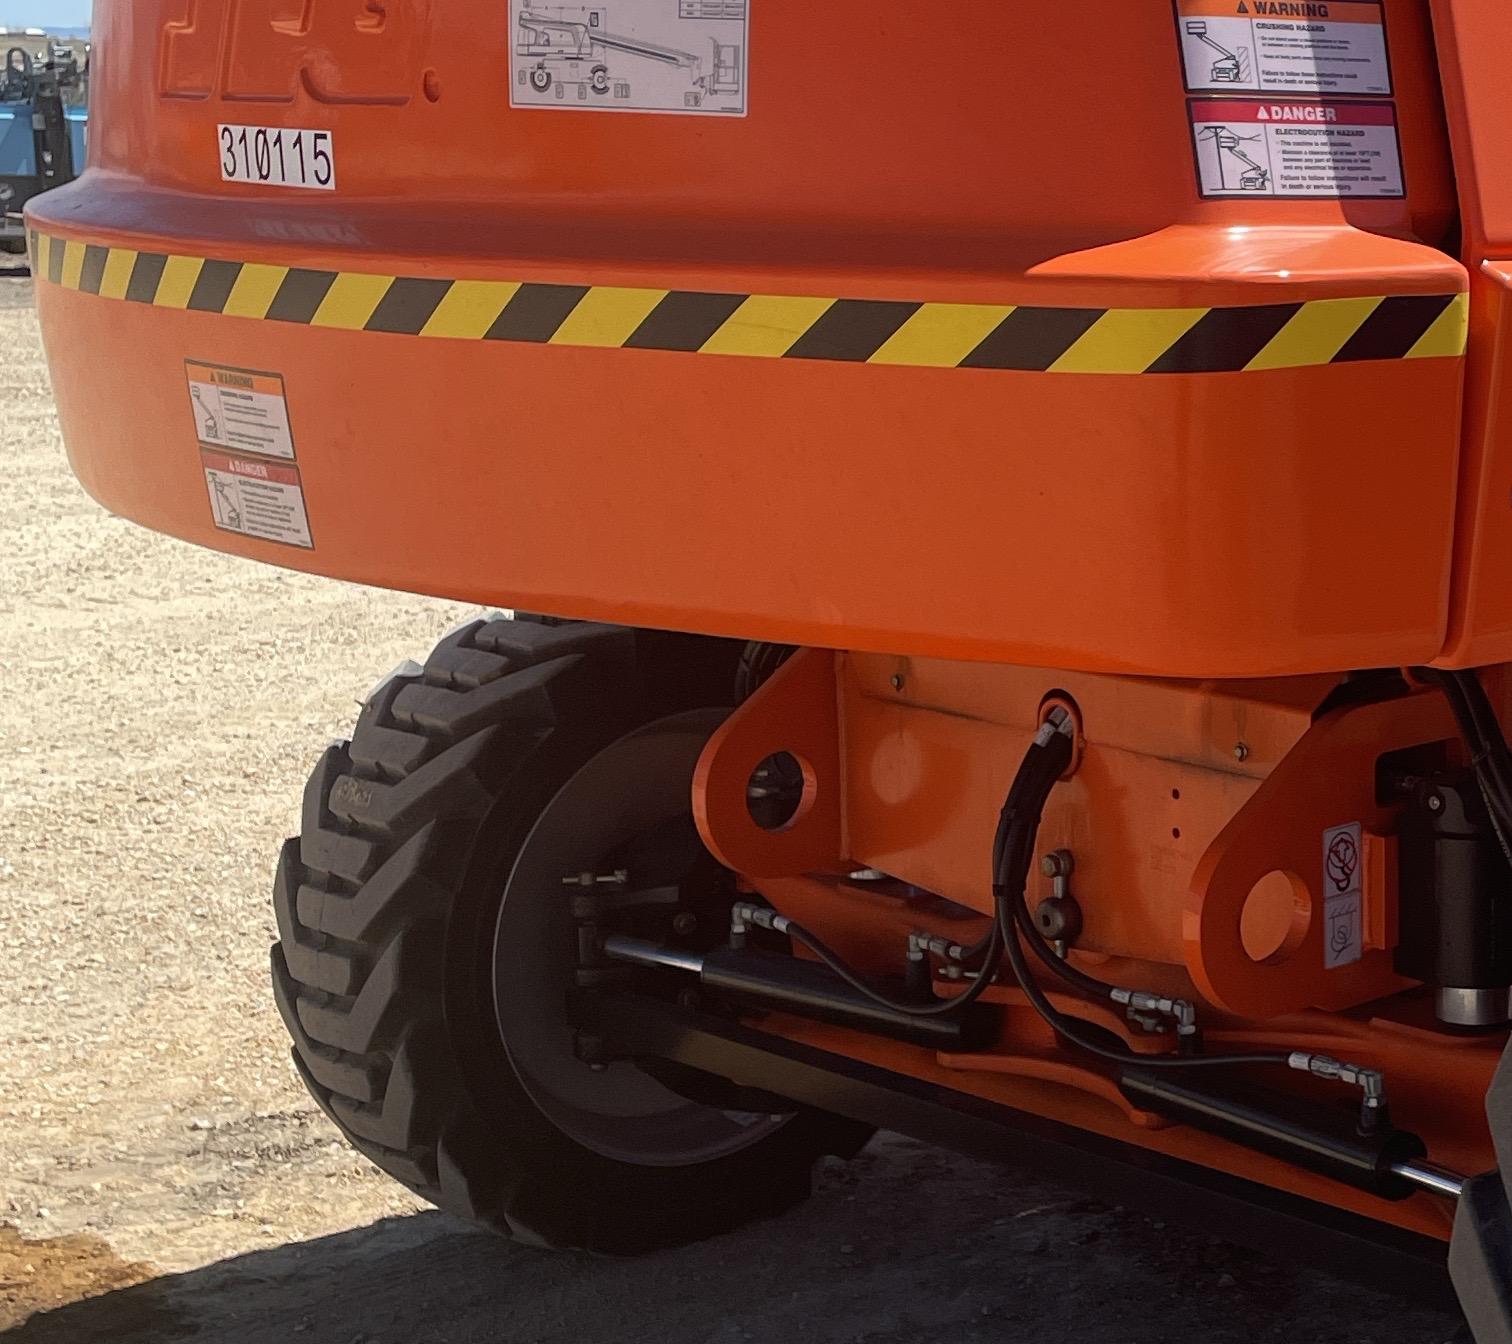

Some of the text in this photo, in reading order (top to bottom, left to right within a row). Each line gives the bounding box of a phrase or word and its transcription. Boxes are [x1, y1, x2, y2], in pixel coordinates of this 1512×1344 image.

[1253, 1, 1329, 18] WARNING
[1271, 105, 1337, 122] DANGER
[221, 126, 333, 186] 310115
